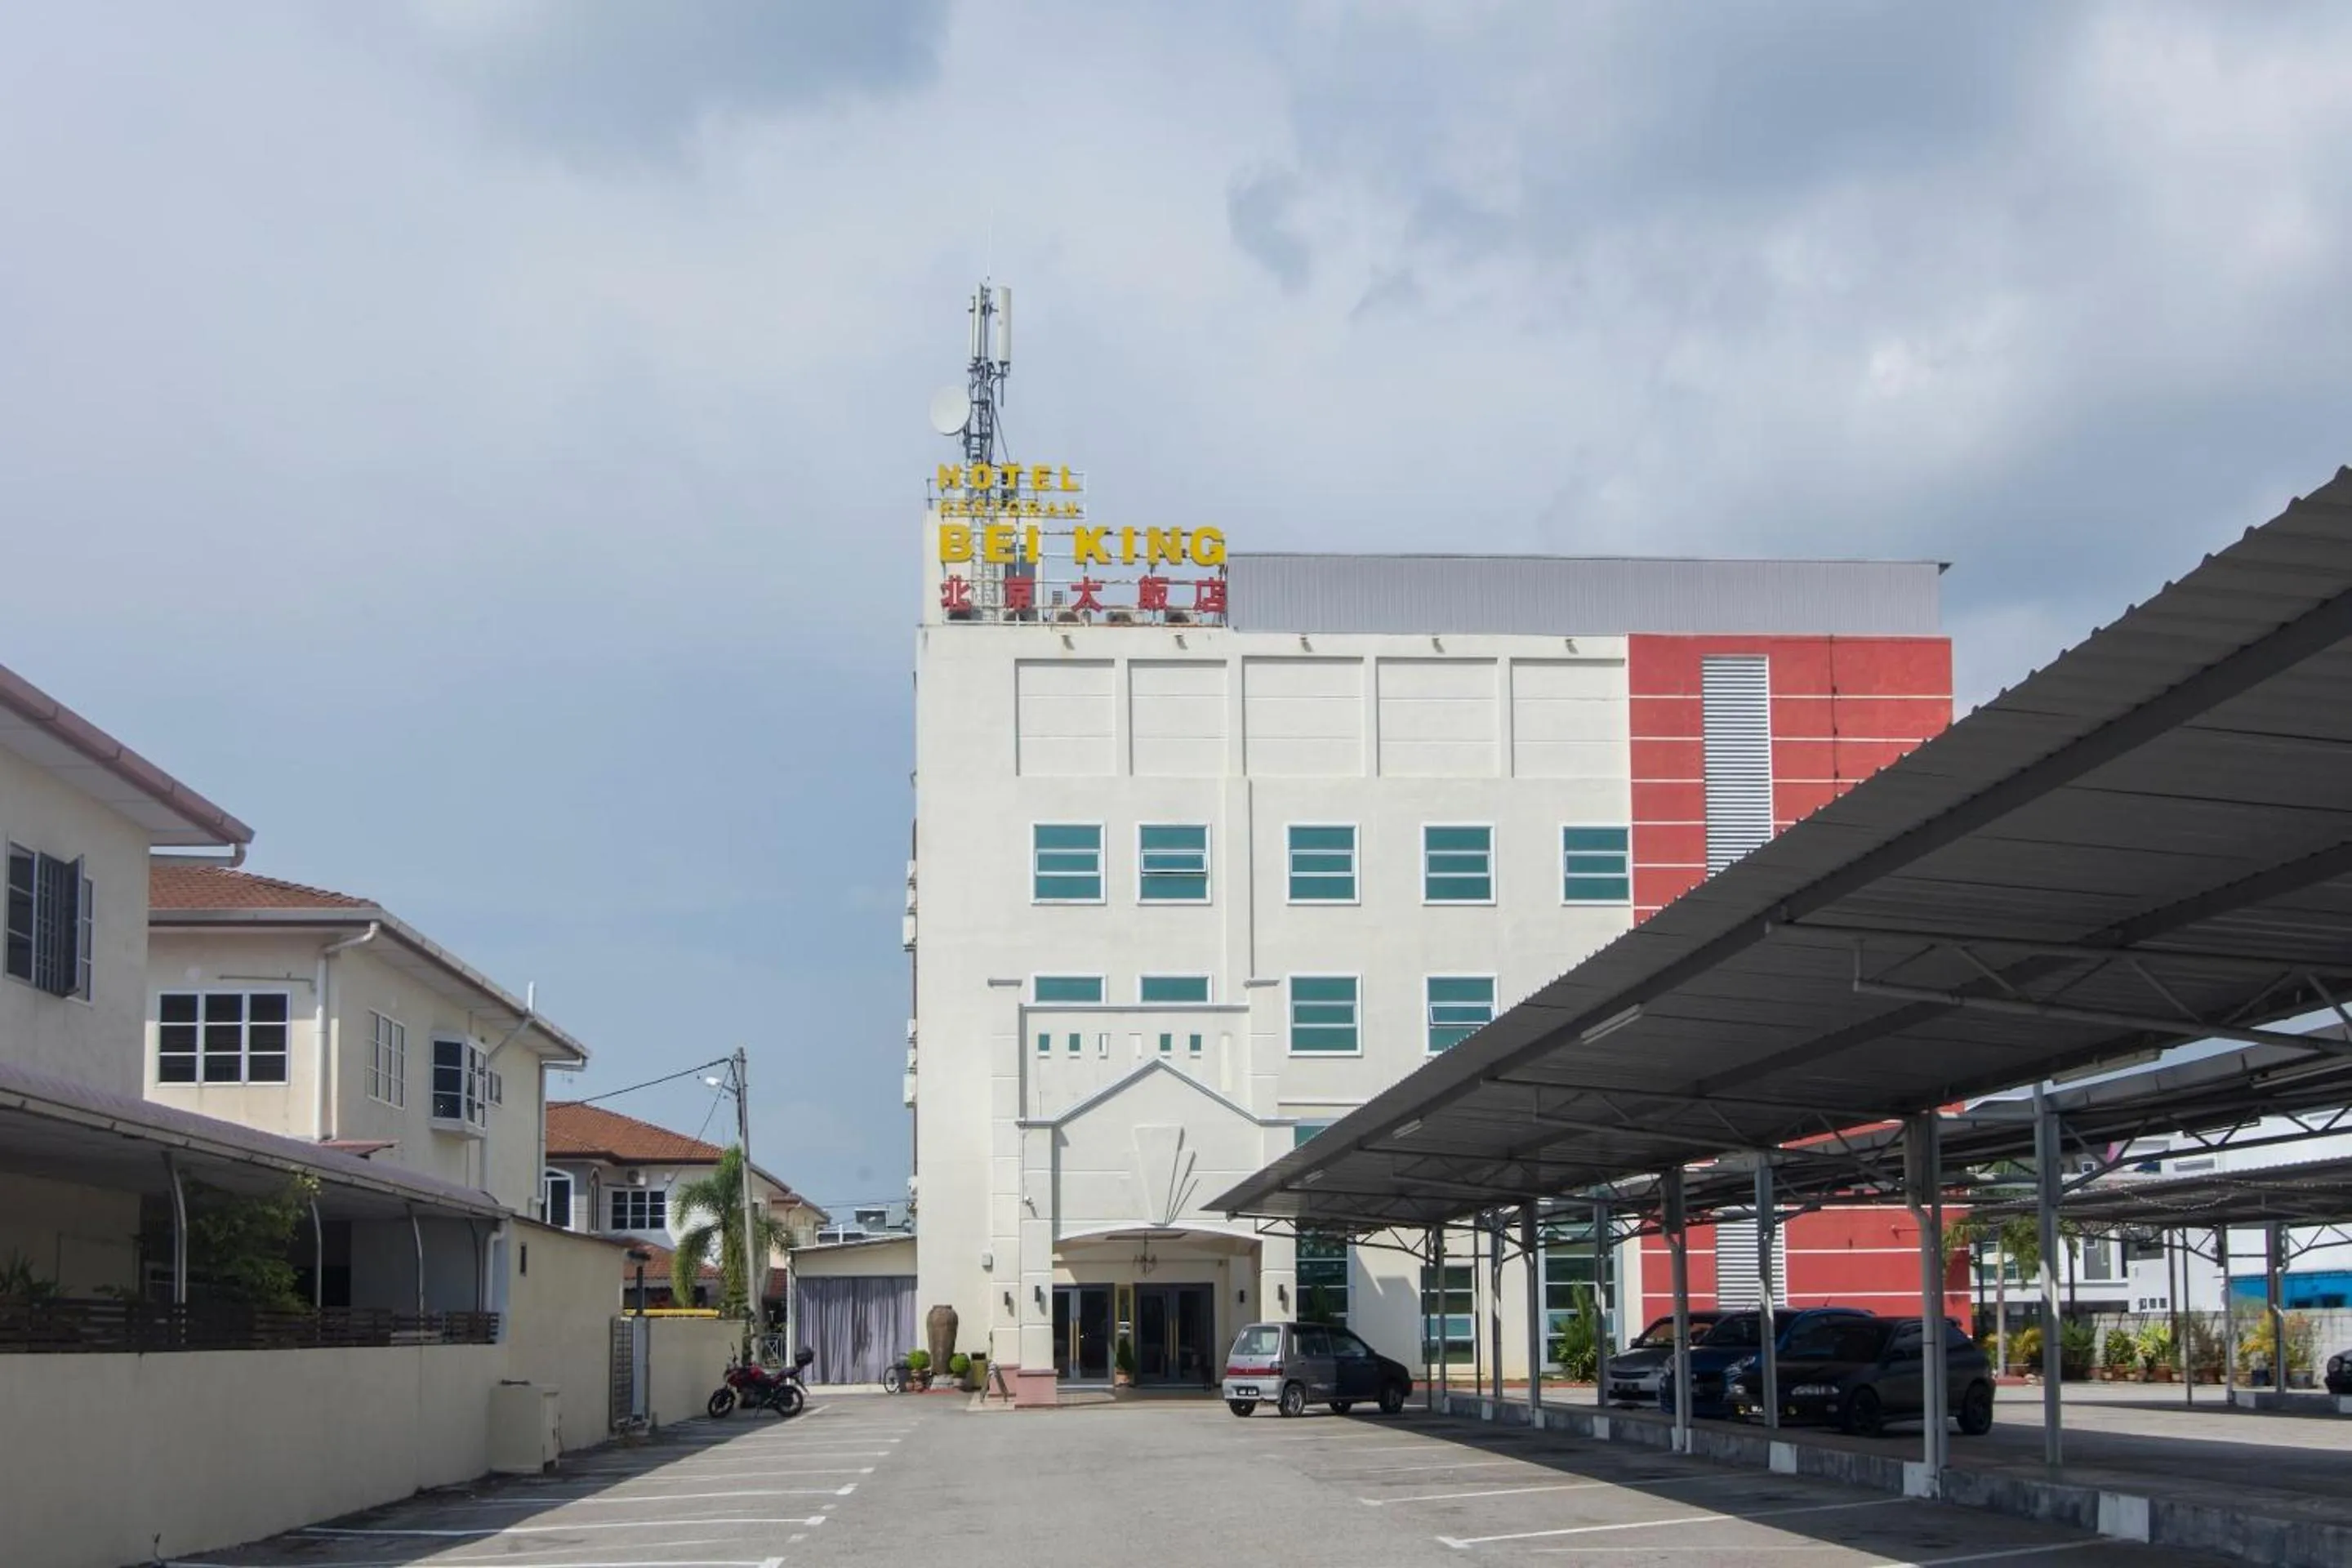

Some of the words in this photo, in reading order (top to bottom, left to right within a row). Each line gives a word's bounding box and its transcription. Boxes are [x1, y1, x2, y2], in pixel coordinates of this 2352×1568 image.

[938, 463, 1079, 491] HOTEL
[939, 524, 1039, 564] BEI
[1074, 526, 1227, 566] KING
[940, 574, 1227, 612] 北京大飯店
